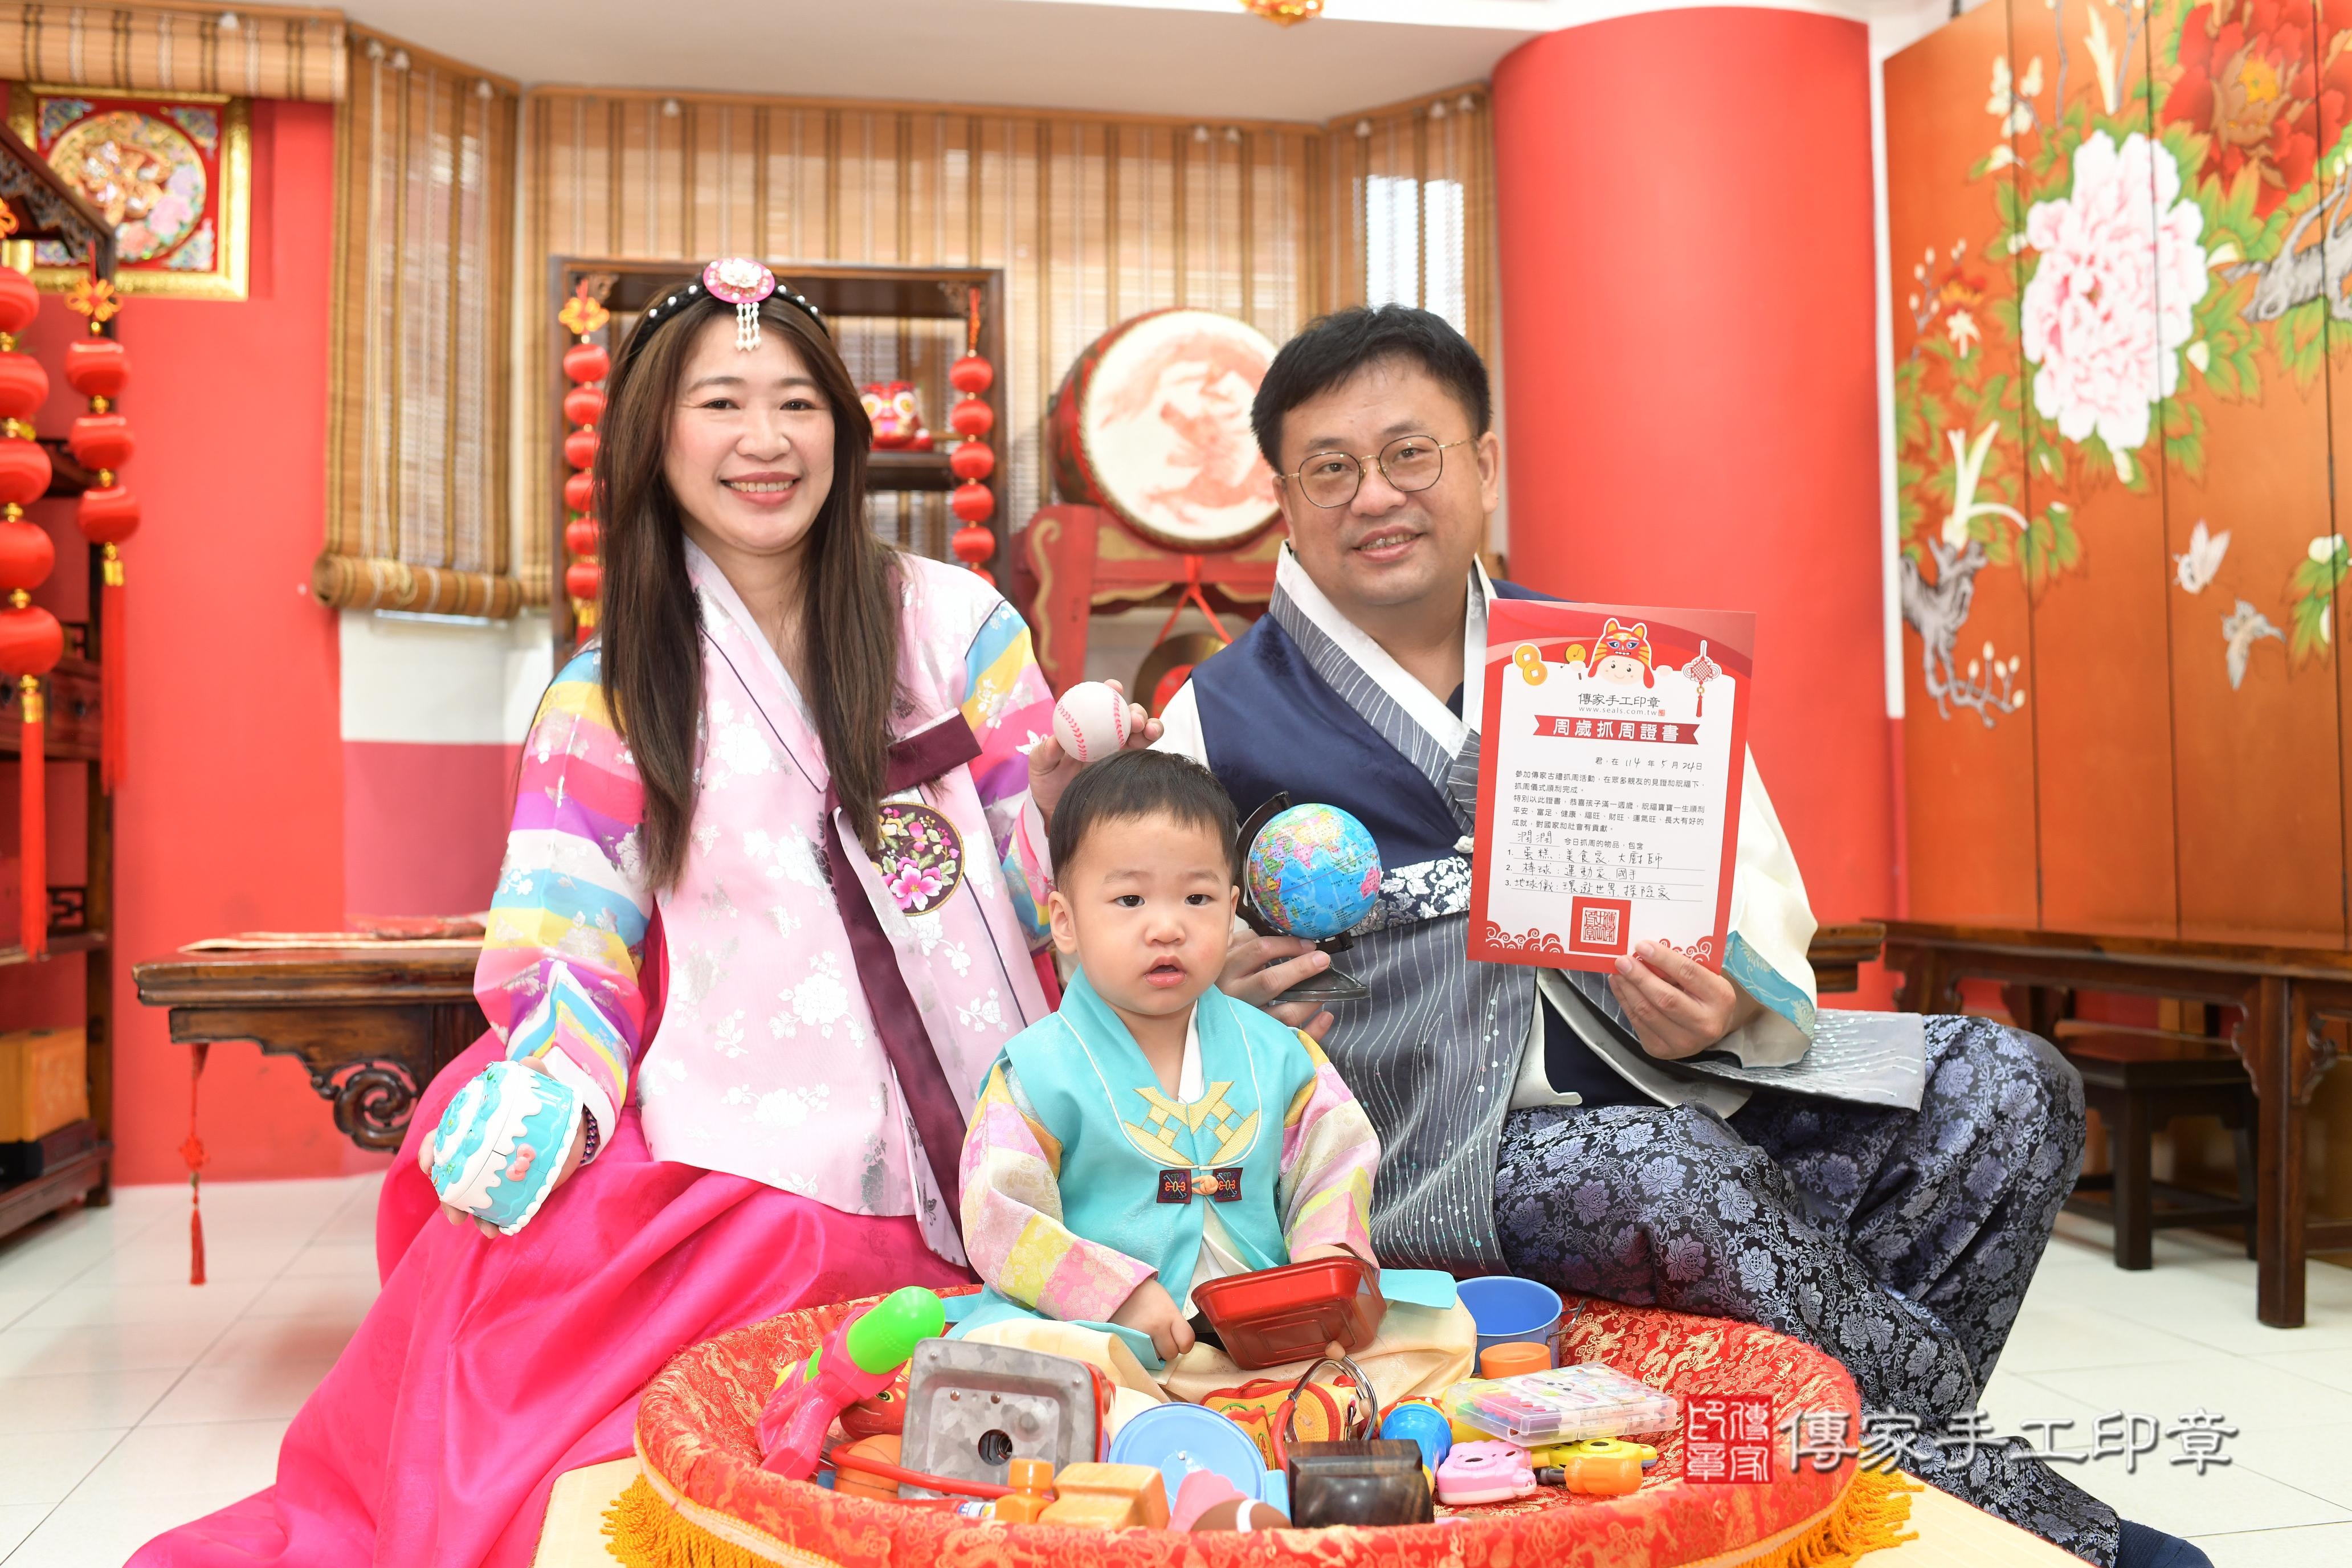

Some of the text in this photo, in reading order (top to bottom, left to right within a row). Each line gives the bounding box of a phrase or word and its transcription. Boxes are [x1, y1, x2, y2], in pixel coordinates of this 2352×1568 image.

[1578, 693, 1660, 708] 傳家手工印章
[1579, 707, 1657, 716] www.seals.com.tw
[1553, 718, 1679, 742] 周歲抓周證書
[1514, 782, 1584, 793] 抓周儀式順利完成。
